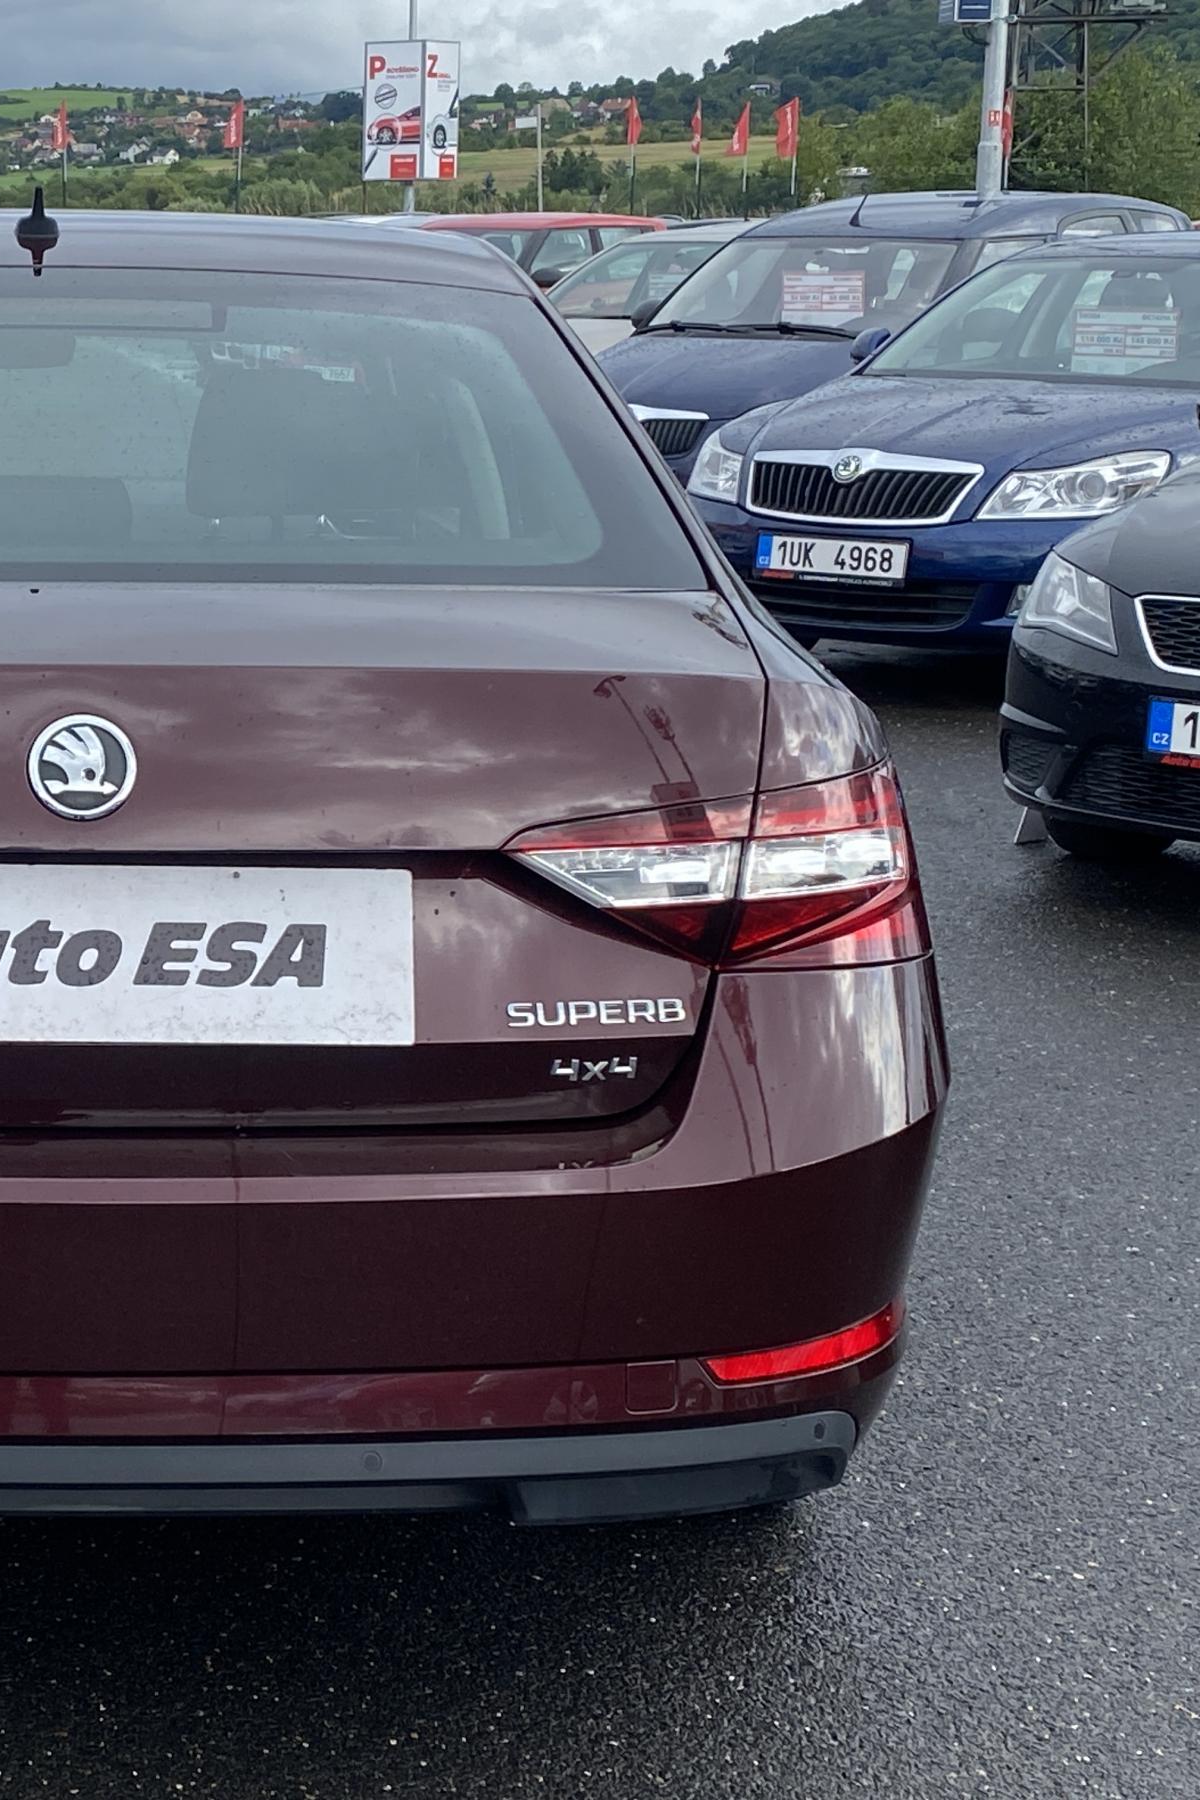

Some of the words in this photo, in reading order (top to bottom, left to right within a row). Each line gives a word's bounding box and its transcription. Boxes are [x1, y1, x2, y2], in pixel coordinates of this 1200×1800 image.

[778, 540, 816, 569] 1UK
[834, 544, 894, 573] 4968
[1152, 732, 1170, 745] CZ
[132, 921, 327, 988] ESA
[506, 998, 687, 1027] SUPERB
[551, 1056, 638, 1082] 4x4
